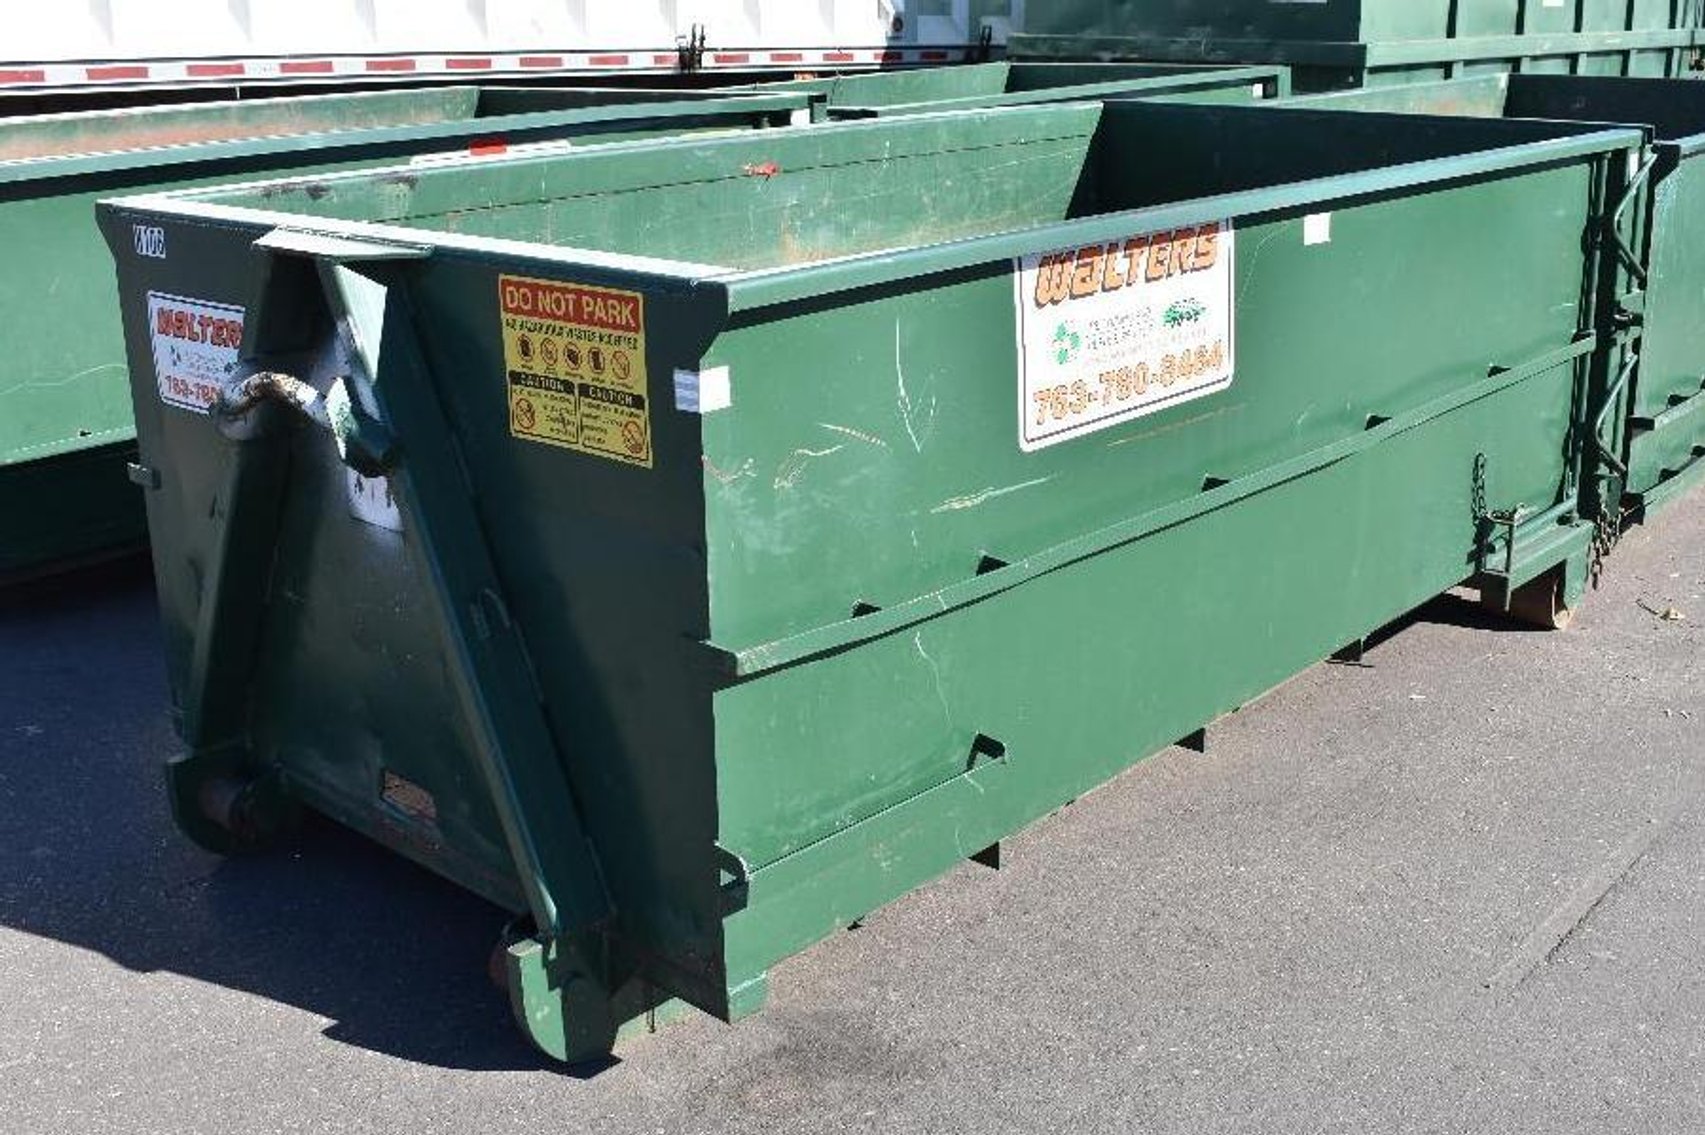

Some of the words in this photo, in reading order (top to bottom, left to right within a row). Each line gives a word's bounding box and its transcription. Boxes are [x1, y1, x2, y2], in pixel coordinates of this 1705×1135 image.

[1034, 221, 1219, 309] WALTERS
[505, 285, 532, 311] DO
[539, 289, 577, 318] NOT
[581, 295, 636, 328] PARK
[156, 307, 243, 349] WALTER
[520, 373, 565, 392] CAUTION
[588, 390, 633, 406] CAUTION
